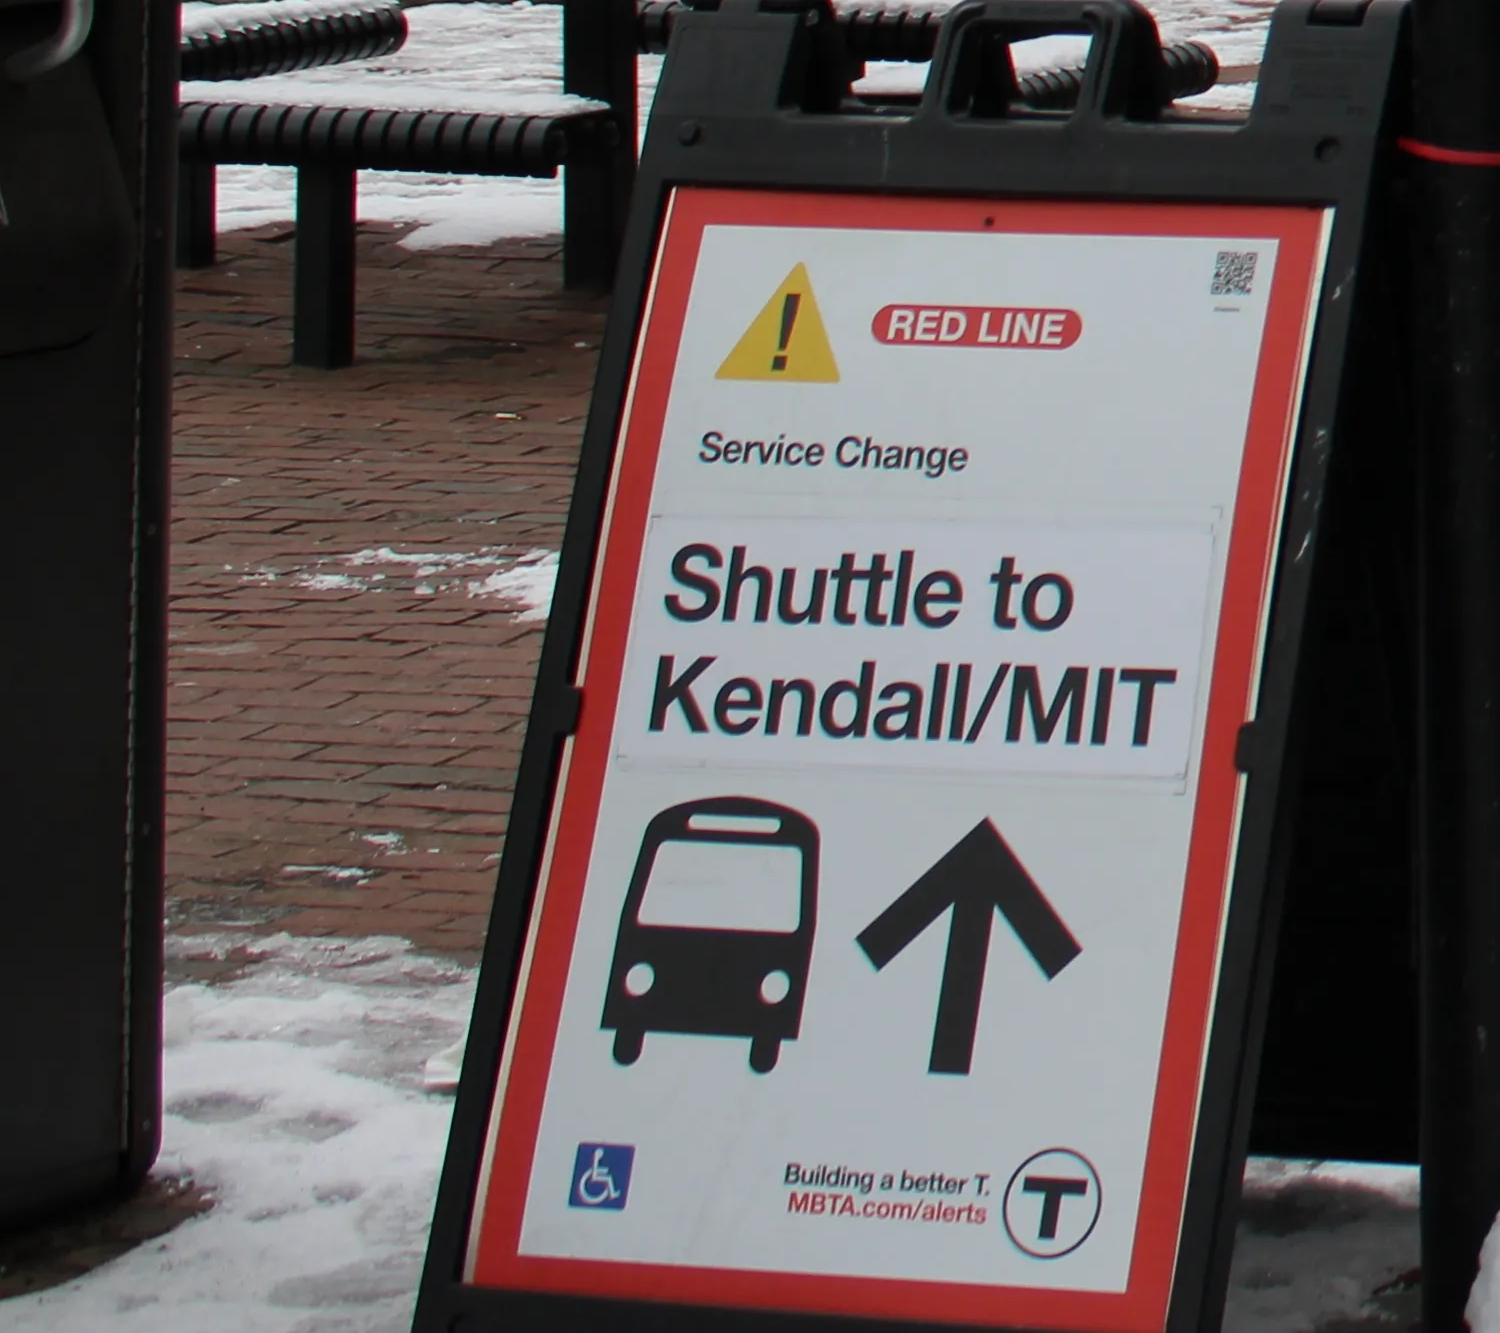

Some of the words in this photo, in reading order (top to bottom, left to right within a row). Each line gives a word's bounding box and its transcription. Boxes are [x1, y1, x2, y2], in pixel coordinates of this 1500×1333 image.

[886, 308, 968, 343] RED
[976, 310, 1066, 347] LINE
[698, 432, 825, 468] Service
[834, 435, 970, 479] Change
[663, 542, 965, 630] Shuttle
[989, 556, 1075, 632] to
[647, 653, 1179, 748] Kendall/MIT
[783, 1162, 875, 1195] Building
[879, 1174, 894, 1190] a
[899, 1169, 968, 1196] better
[973, 1174, 991, 1197] T.
[786, 1191, 988, 1226] MBTA.com/alerts
[1022, 1175, 1089, 1241] T
